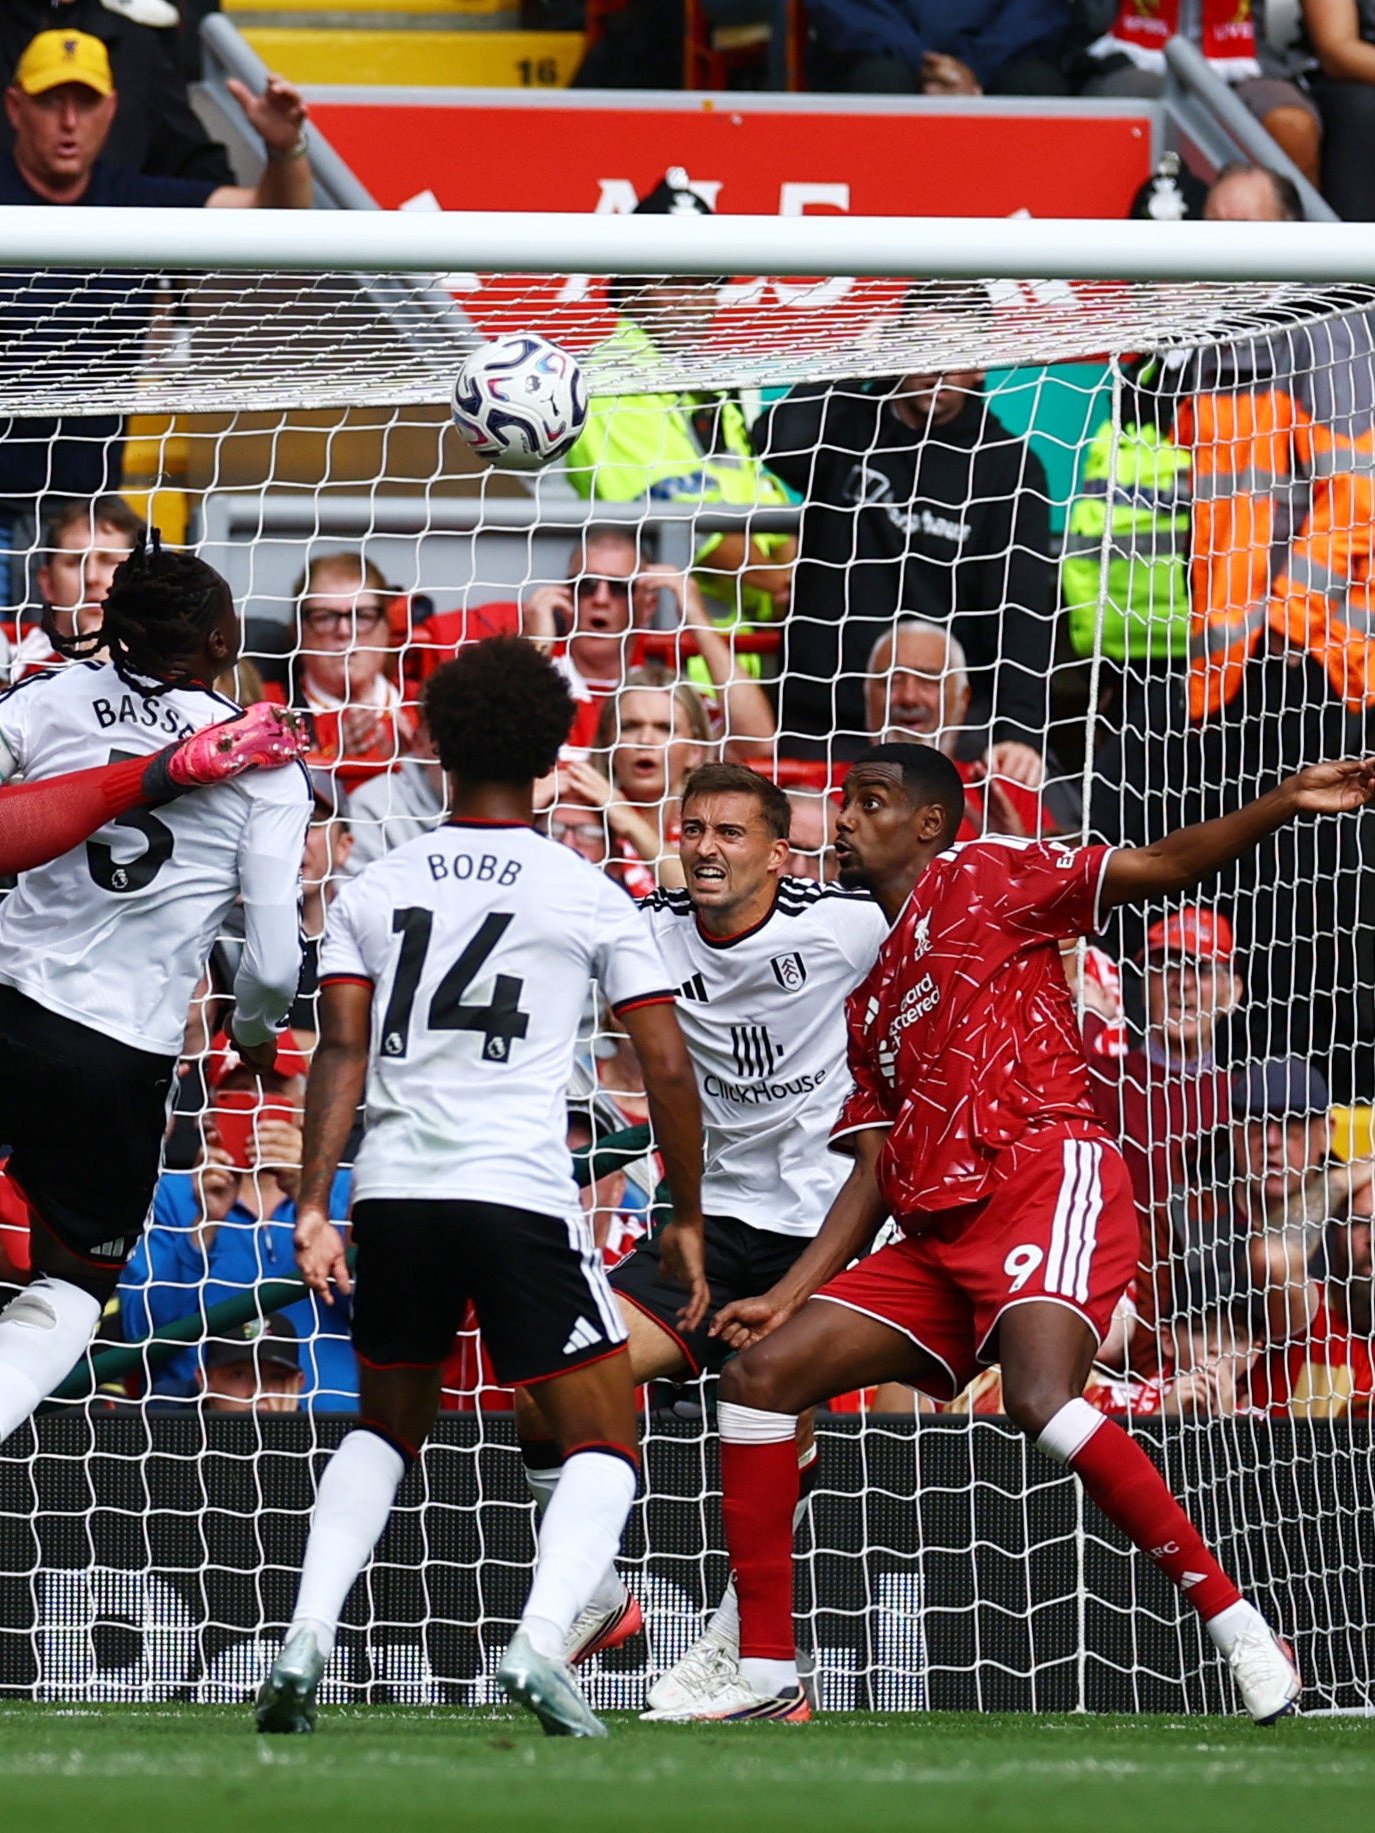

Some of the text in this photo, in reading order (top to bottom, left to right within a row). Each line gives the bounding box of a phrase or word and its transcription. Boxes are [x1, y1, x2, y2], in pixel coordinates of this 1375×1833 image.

[516, 57, 557, 85] 16
[92, 694, 196, 741] BASSE
[427, 853, 523, 887] BOBB
[379, 905, 531, 1064] 14
[703, 1068, 827, 1105] ClickHouse
[1003, 1243, 1045, 1294] 9
